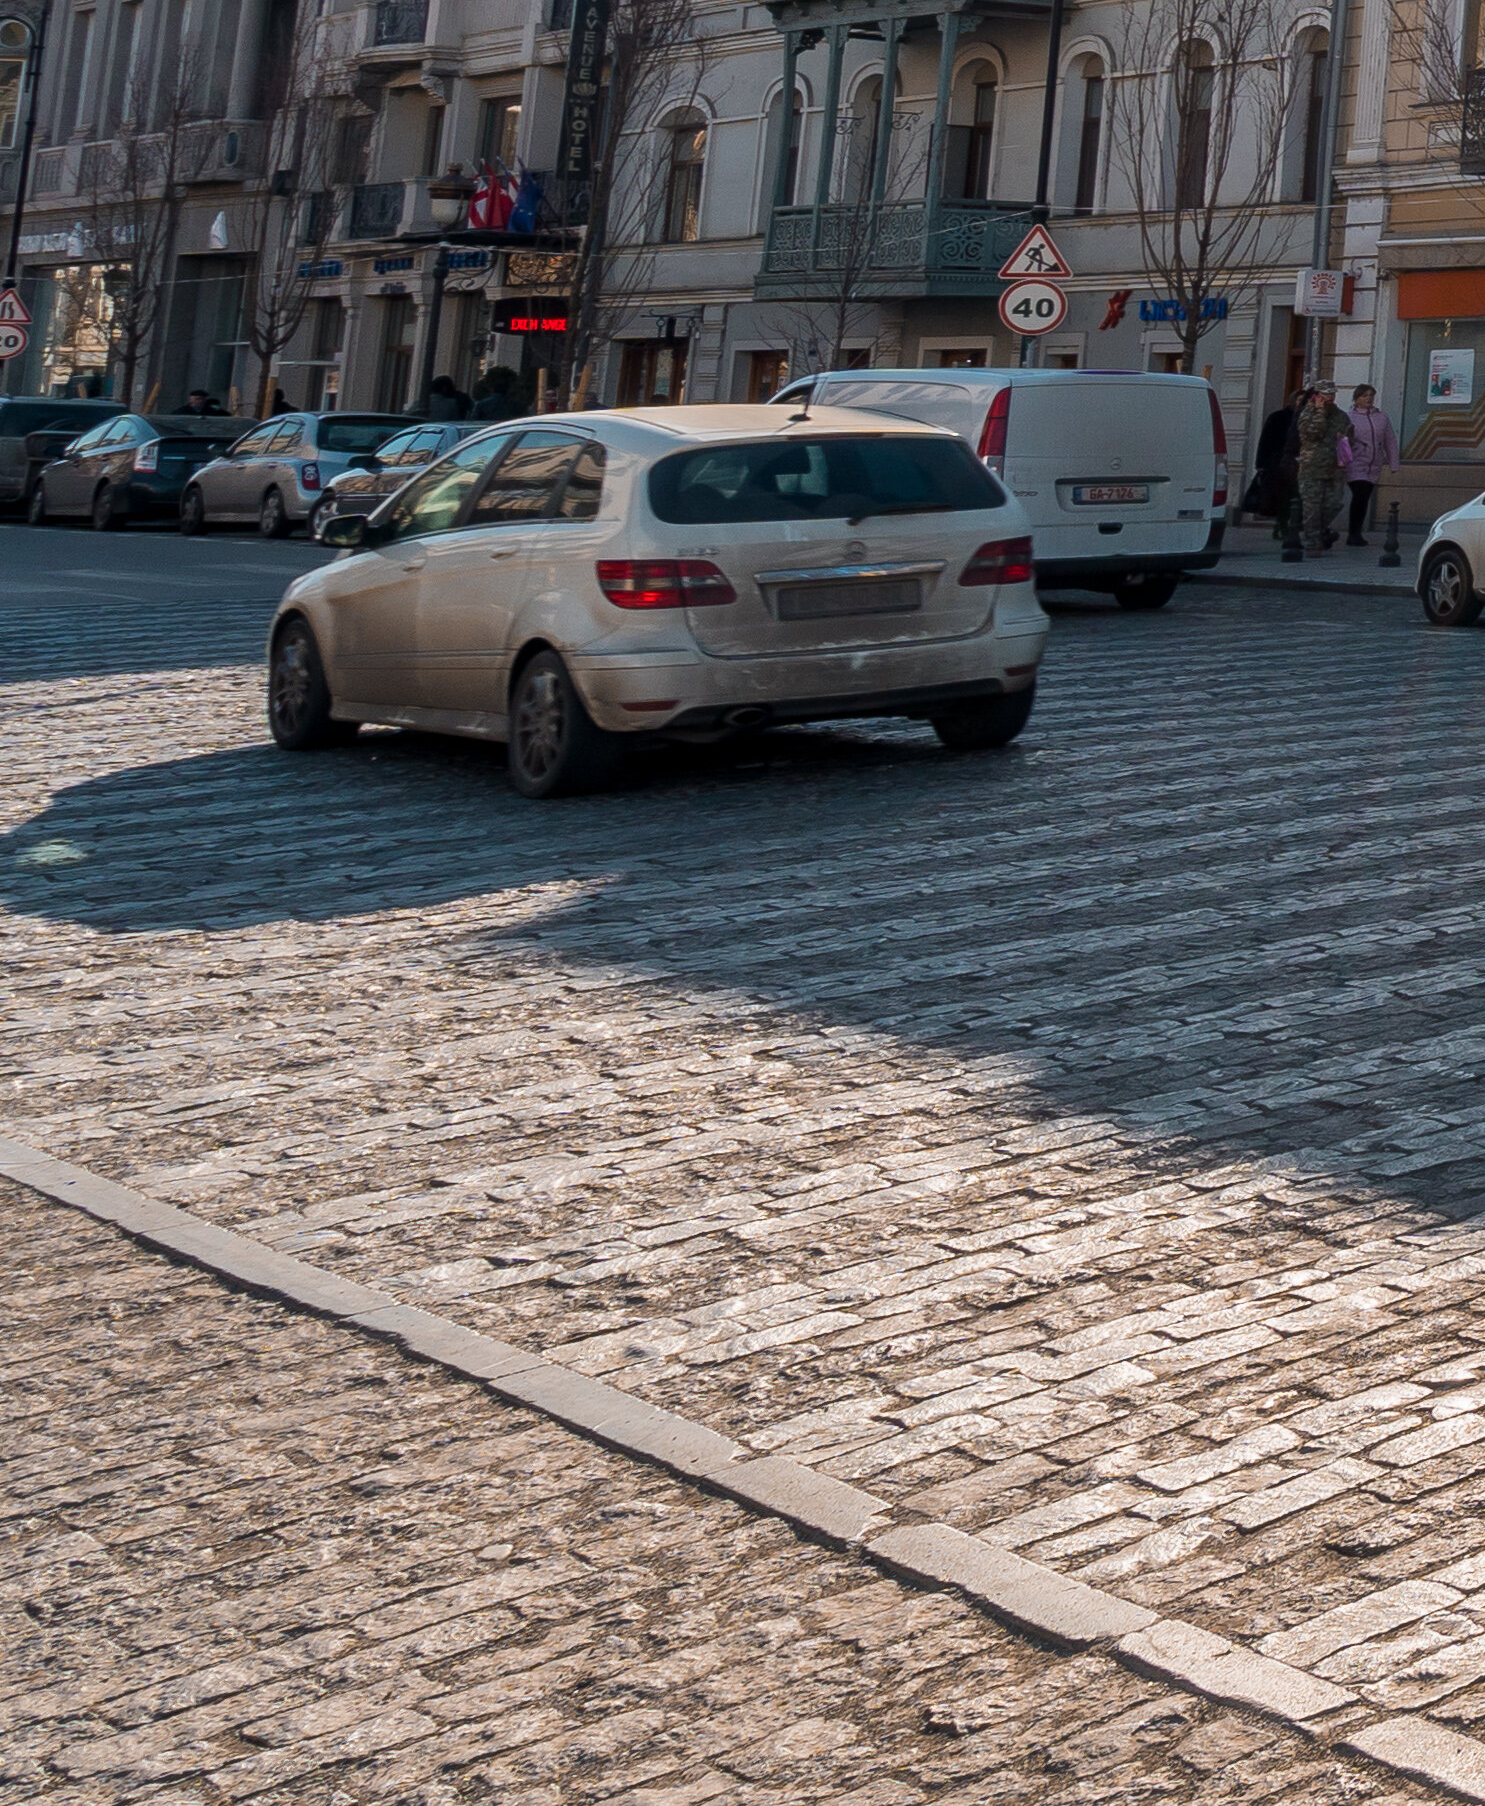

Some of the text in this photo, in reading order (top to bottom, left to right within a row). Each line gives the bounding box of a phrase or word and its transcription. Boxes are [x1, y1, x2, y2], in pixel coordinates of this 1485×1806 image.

[580, 8, 600, 80] AVENUE
[568, 108, 588, 172] HOTEL
[1011, 296, 1056, 318] 40
